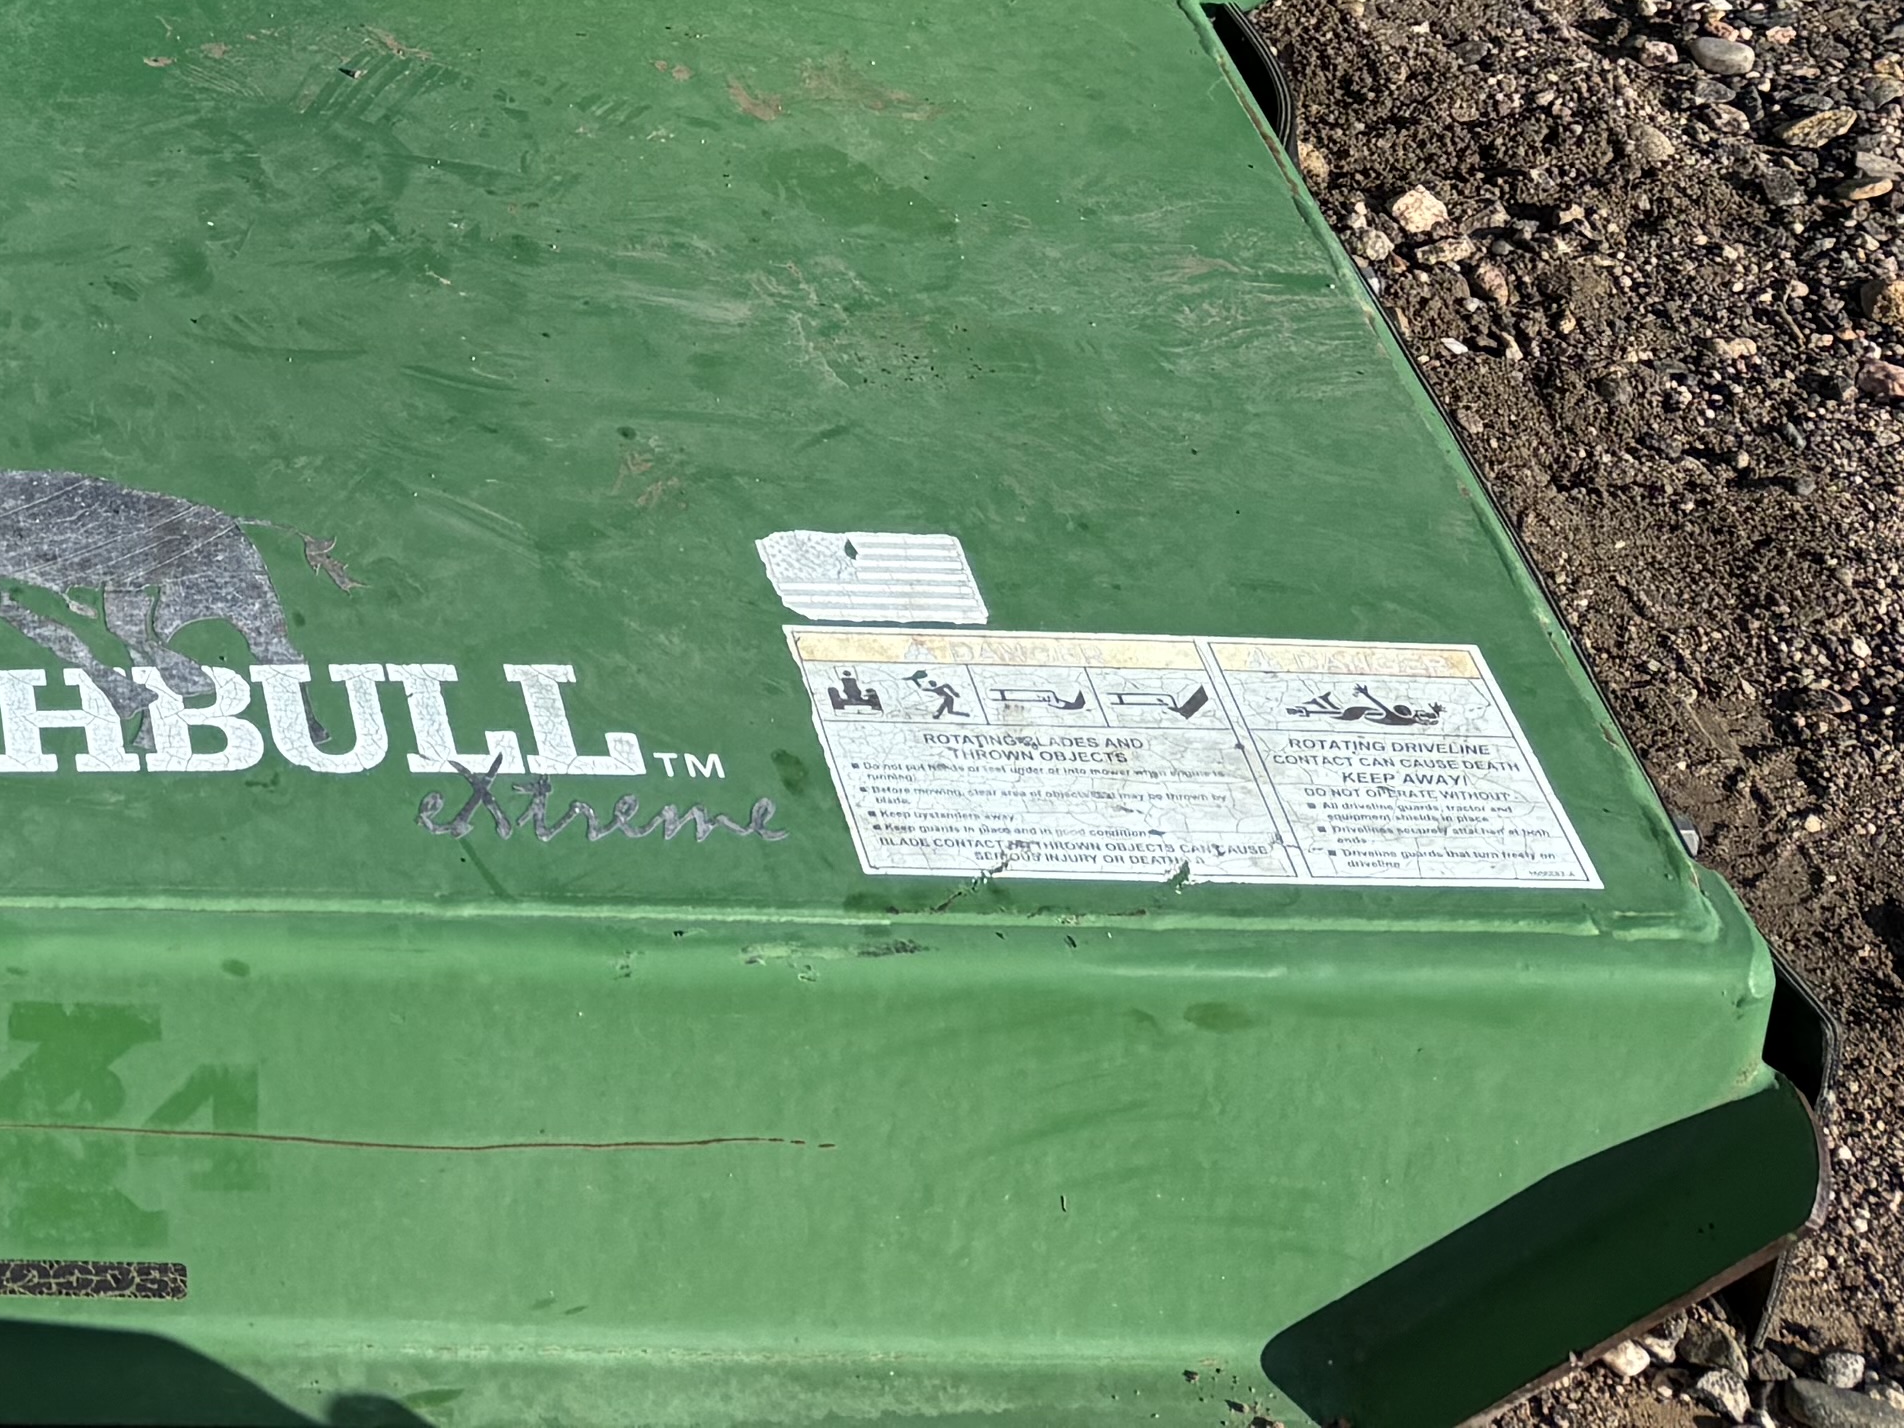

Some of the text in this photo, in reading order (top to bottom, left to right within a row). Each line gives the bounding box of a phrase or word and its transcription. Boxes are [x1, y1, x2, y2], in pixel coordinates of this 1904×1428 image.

[923, 733, 1018, 747] ROTATING
[1105, 737, 1144, 750] AND
[1289, 738, 1490, 755] ROTATING DRIVELINE
[948, 747, 1128, 763] THROWN OBJECTS
[863, 762, 880, 770] Do
[883, 763, 902, 771] not
[1090, 768, 1131, 776] mower
[1273, 755, 1521, 772] CONTACT CAN CAUSE DEATH
[1342, 771, 1396, 784] KEEP
[872, 786, 911, 794] Before
[1166, 792, 1209, 801] thrown
[1304, 787, 1327, 797] DO
[1330, 788, 1360, 797] NOT
[1365, 787, 1438, 799] OPERATE
[1323, 802, 1339, 810] All
[1342, 802, 1394, 811] driveline
[880, 809, 912, 819] Keep
[1327, 813, 1391, 822] equipment
[1441, 814, 1453, 822] in
[884, 824, 916, 833] Keep
[1332, 825, 1394, 835] Drivelines
[879, 836, 930, 847] BLADE
[933, 838, 1005, 849] CONTACT
[1105, 843, 1176, 854] OBJECTS
[1179, 844, 1212, 854] CAN
[1214, 844, 1269, 855] CAUSE
[1045, 853, 1098, 864] INJURY
[1103, 854, 1125, 864] OR
[1342, 848, 1397, 858] Driveline
[1400, 850, 1443, 859] guards
[1446, 849, 1470, 858] that
[1472, 850, 1499, 858] turn
[1539, 852, 1556, 860] on
